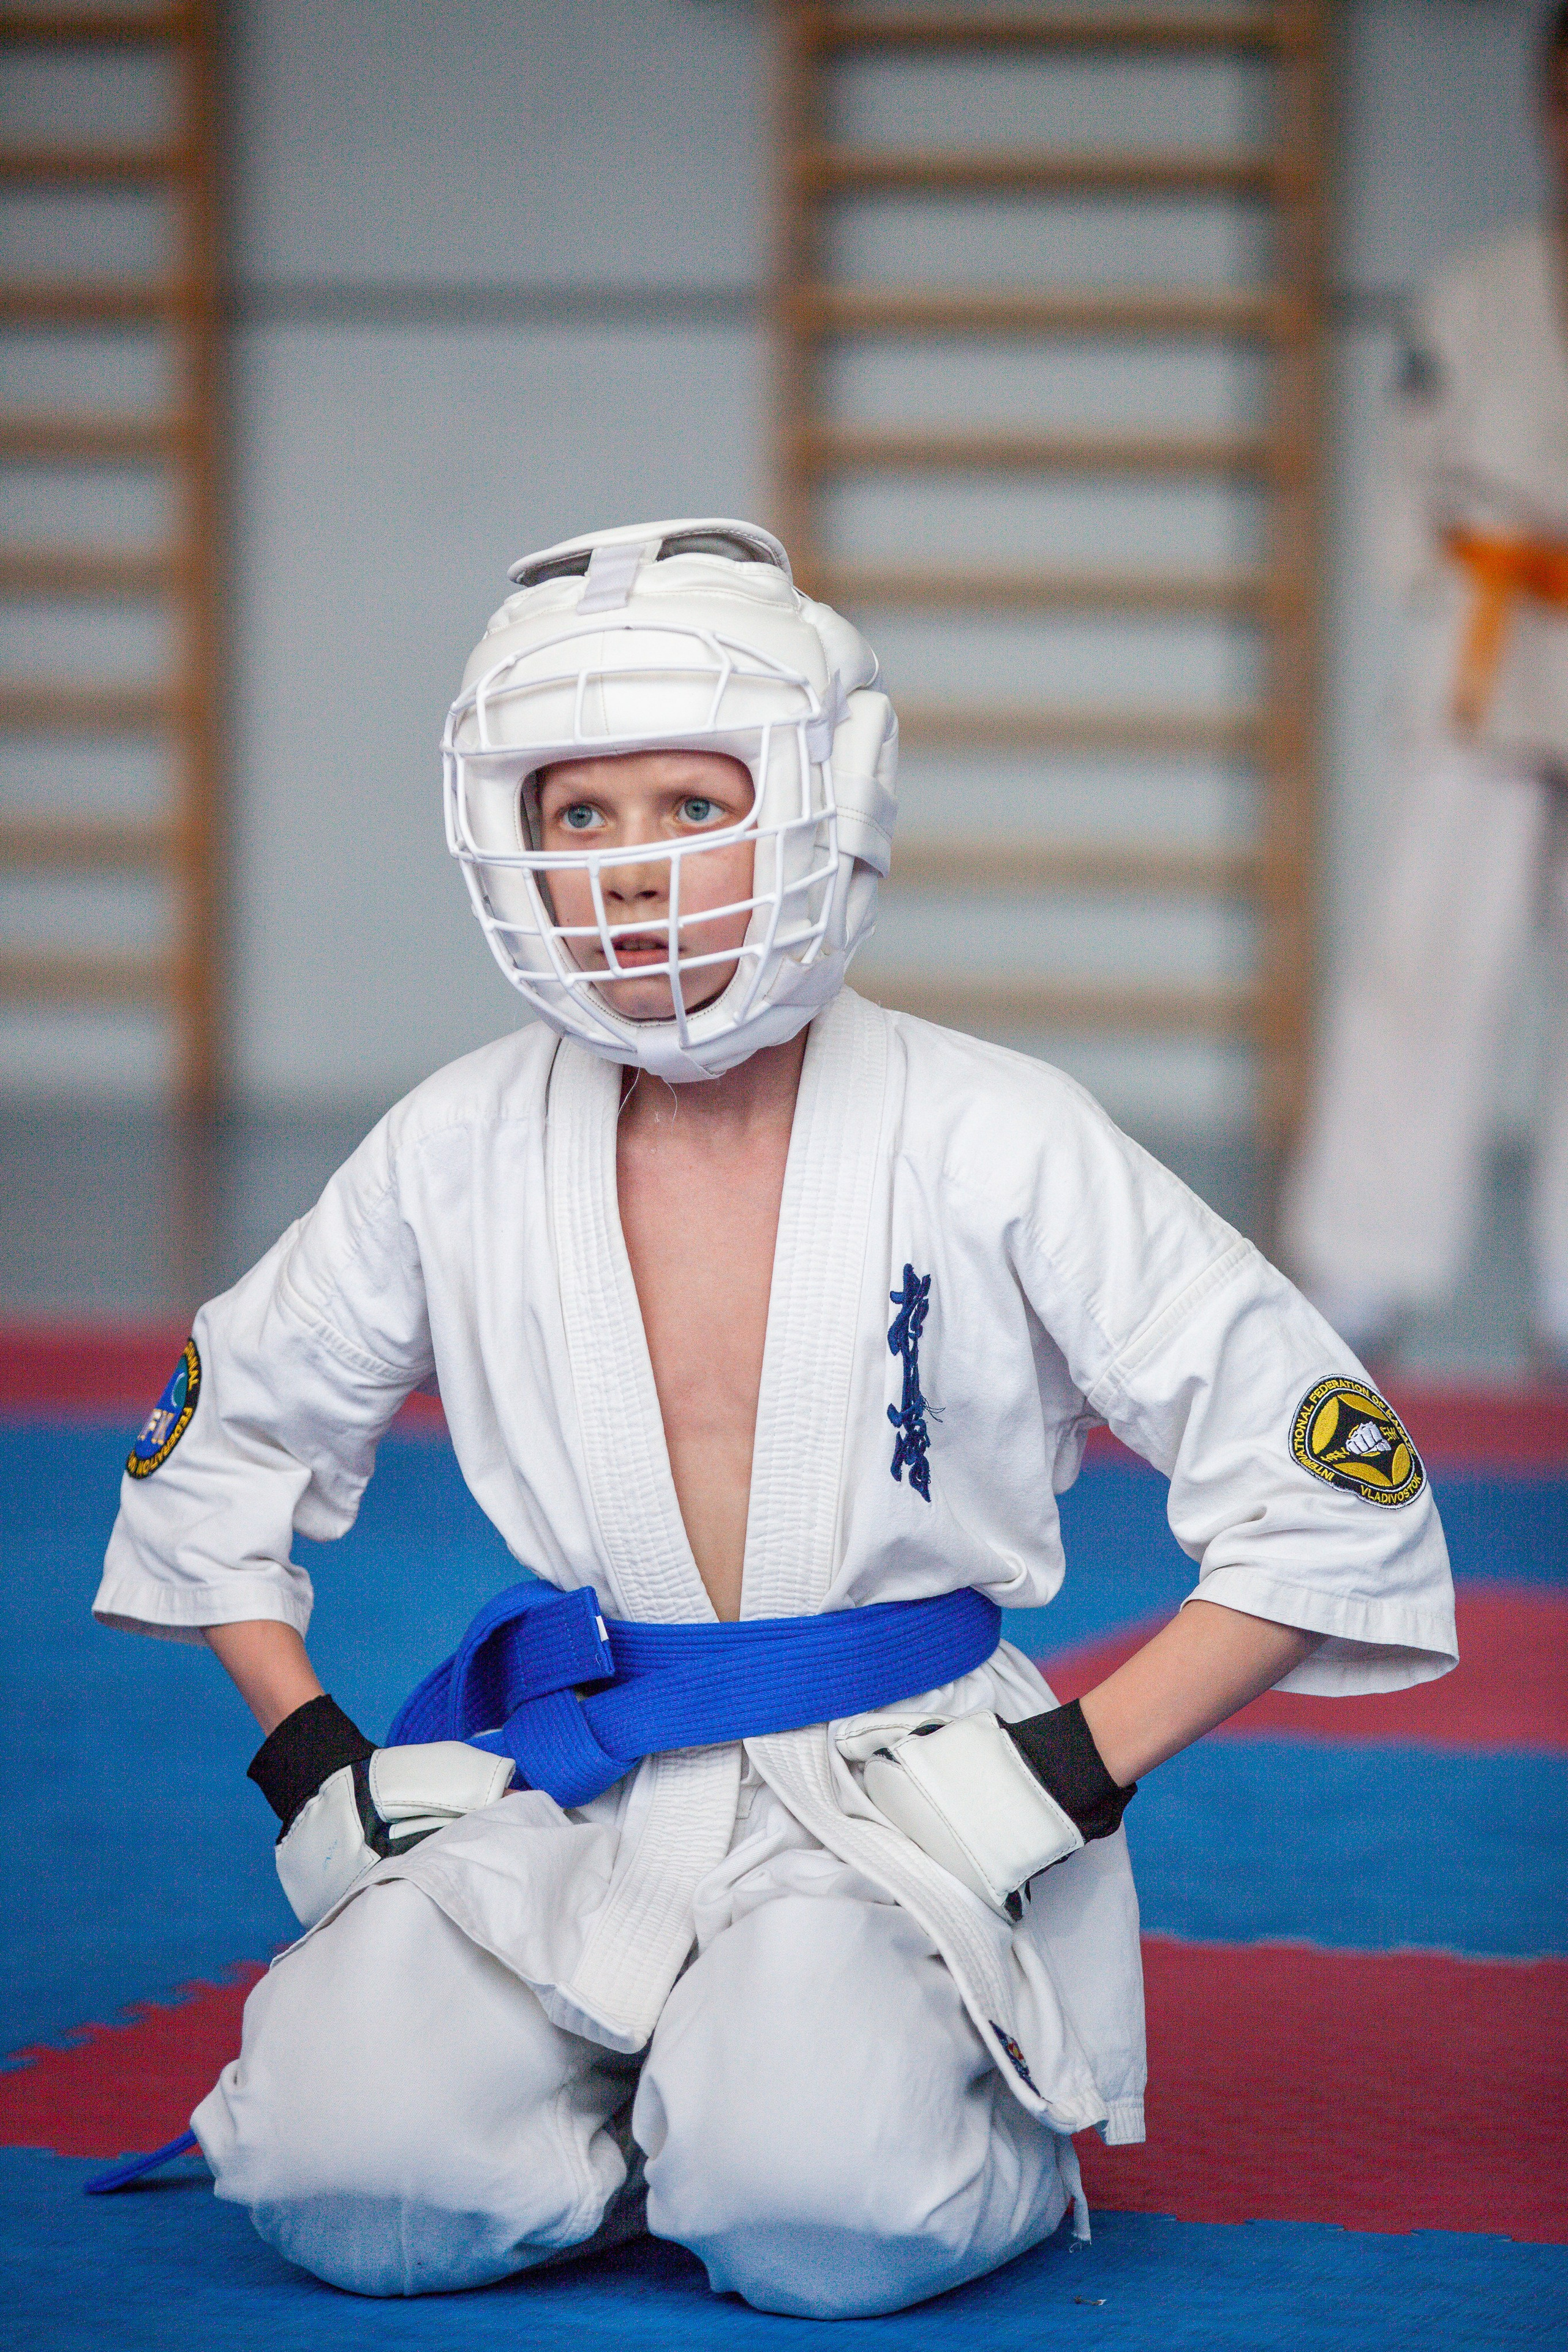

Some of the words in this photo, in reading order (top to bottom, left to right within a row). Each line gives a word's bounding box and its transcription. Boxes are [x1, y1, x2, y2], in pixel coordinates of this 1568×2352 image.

[1310, 1379, 1370, 1404] FEDERATION
[1371, 1396, 1385, 1409] OF
[1294, 1404, 1333, 1482] INTERNATIONAL
[1386, 1408, 1416, 1456] KARATE
[1360, 1476, 1422, 1504] VLADIVOSTOK
